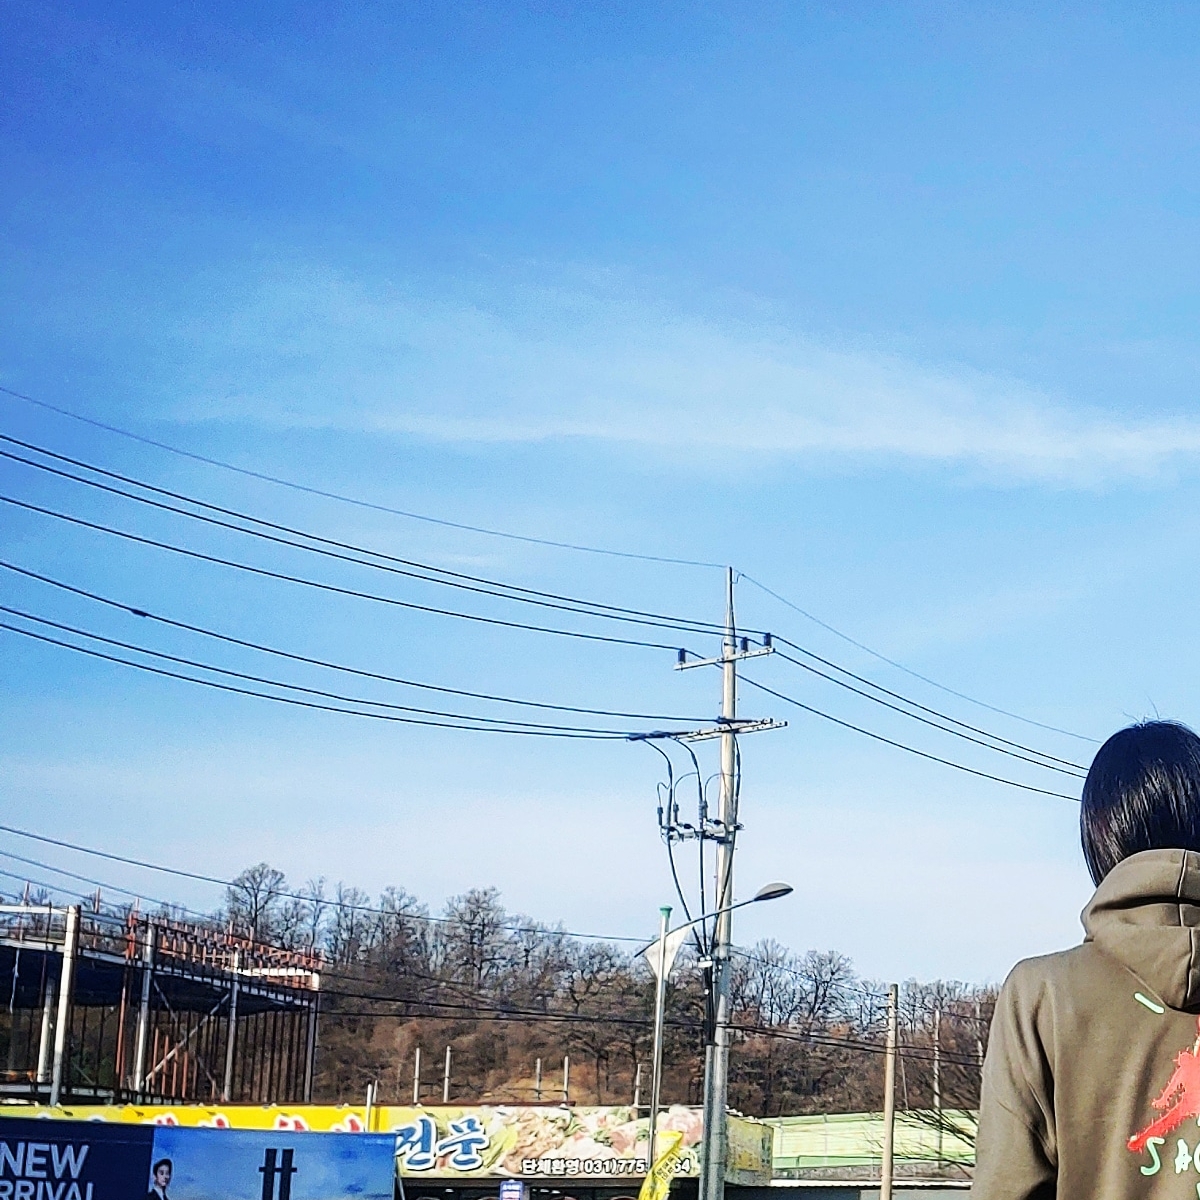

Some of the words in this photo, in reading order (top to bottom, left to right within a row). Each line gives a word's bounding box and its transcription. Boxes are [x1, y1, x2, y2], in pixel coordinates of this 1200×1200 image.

[0, 1142, 90, 1179] NEW
[396, 1117, 487, 1167] 전문
[521, 1158, 581, 1175] 단체환영
